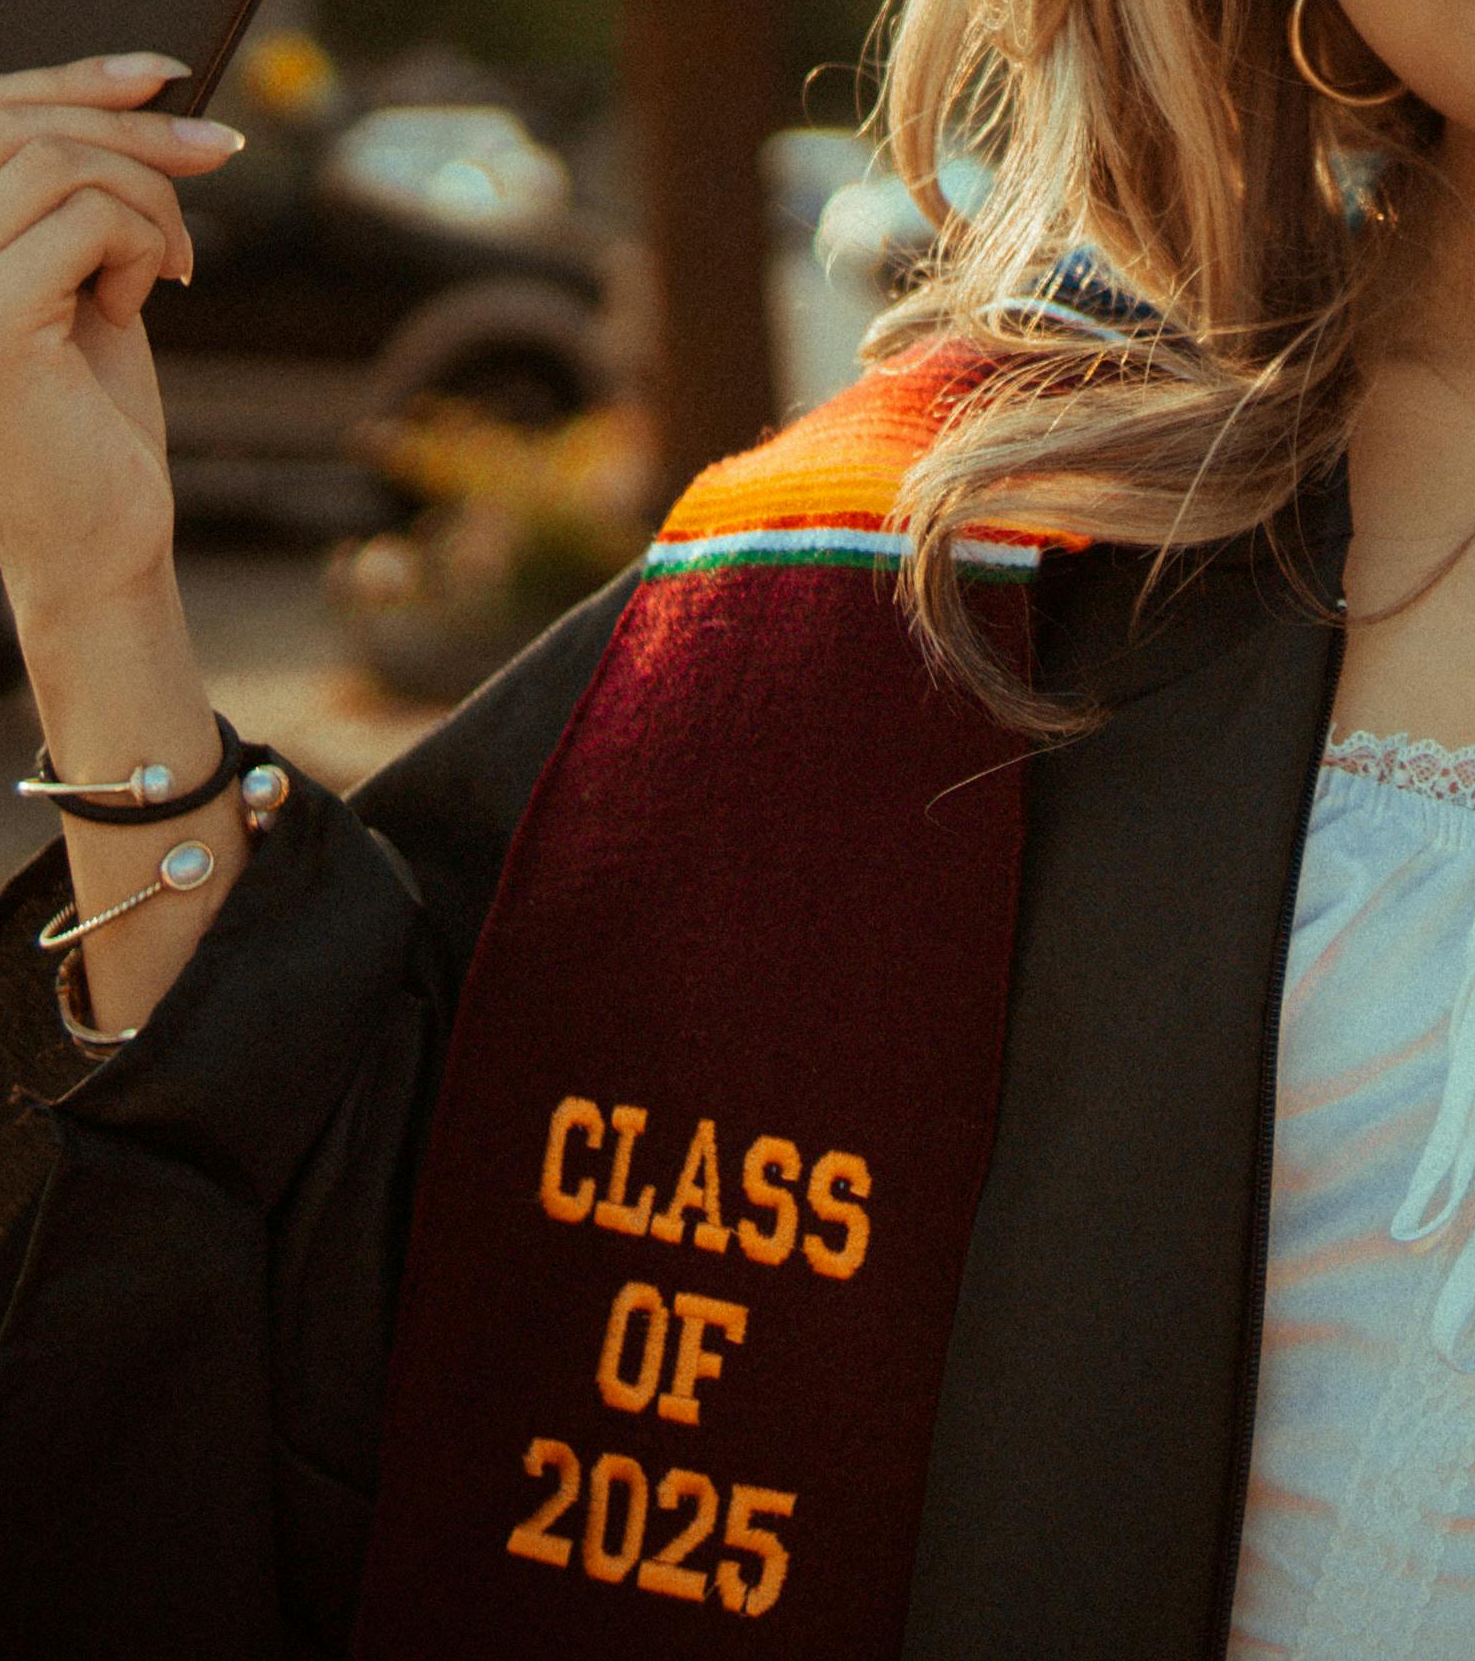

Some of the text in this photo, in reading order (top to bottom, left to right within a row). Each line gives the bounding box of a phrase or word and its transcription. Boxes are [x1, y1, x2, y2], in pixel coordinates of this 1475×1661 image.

[539, 1096, 872, 1280] CLASS
[596, 1282, 748, 1425] OF
[506, 1438, 797, 1617] 2025
